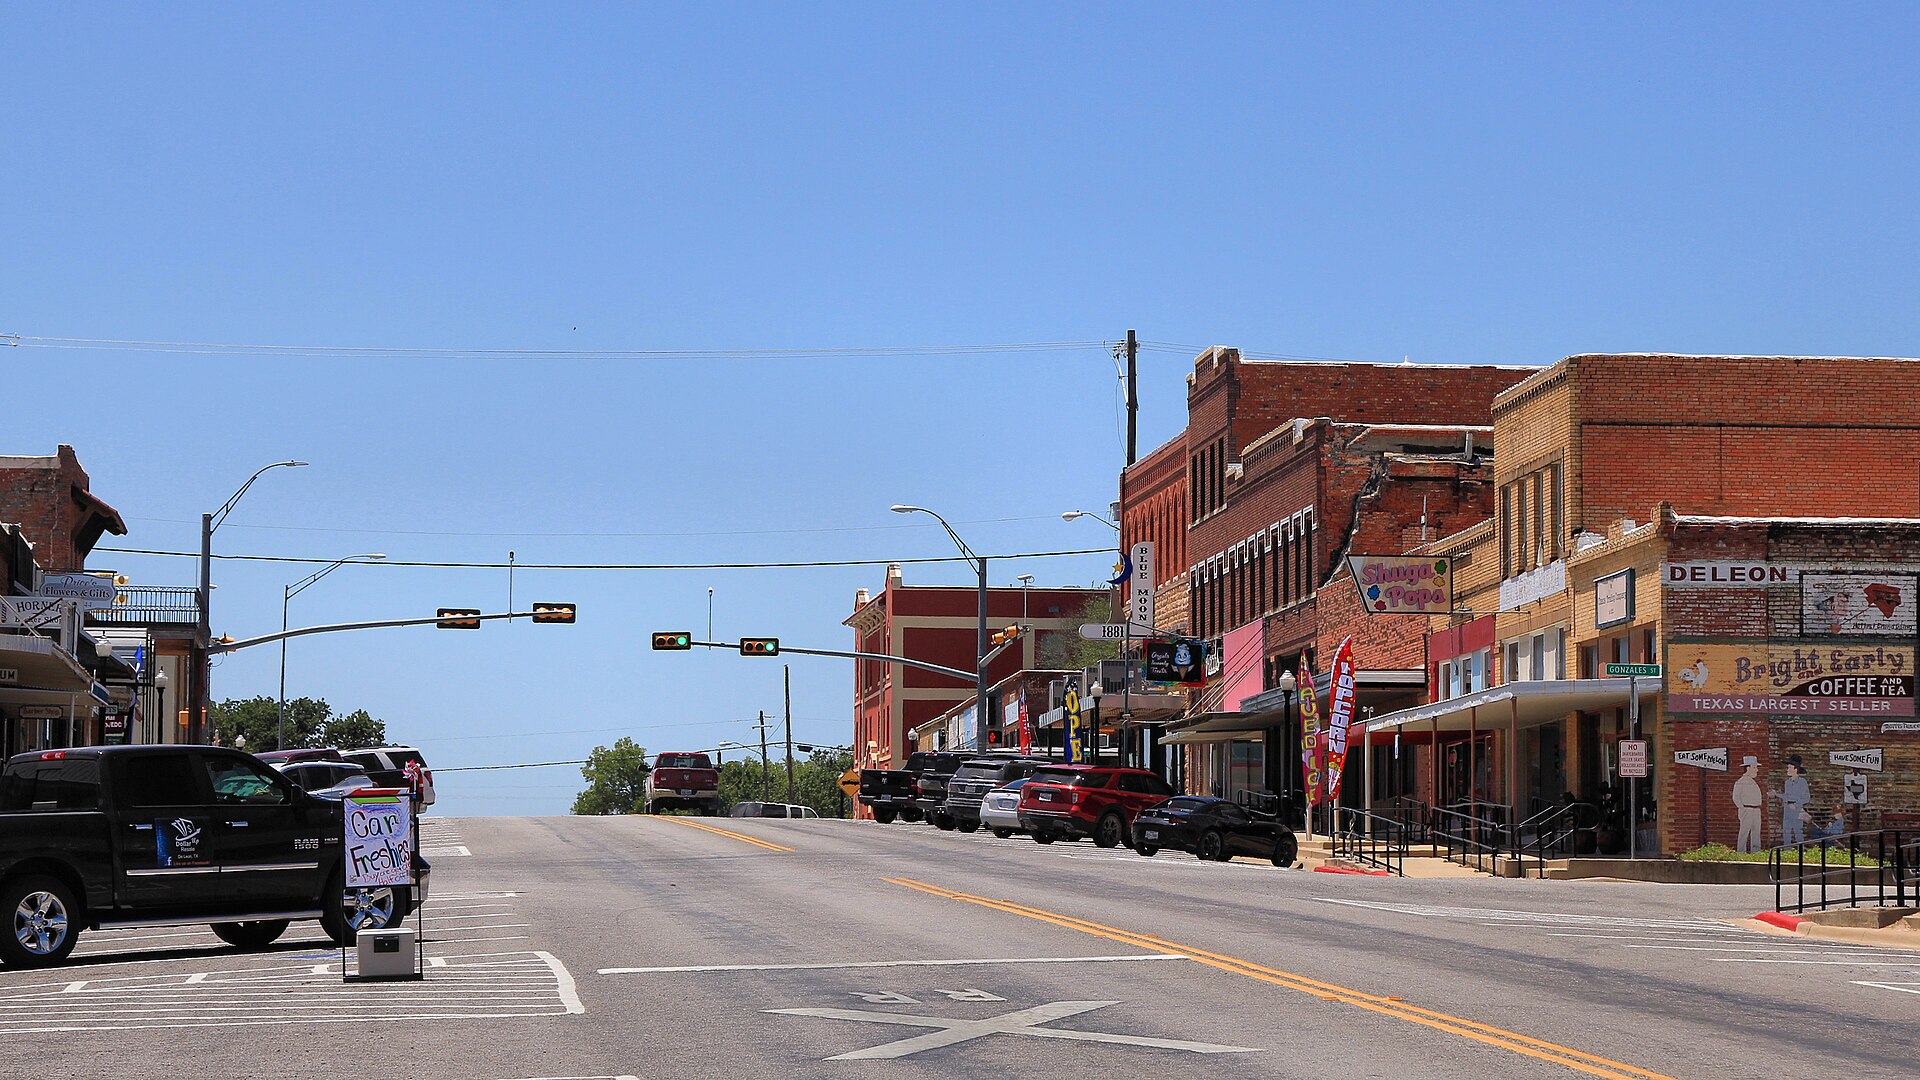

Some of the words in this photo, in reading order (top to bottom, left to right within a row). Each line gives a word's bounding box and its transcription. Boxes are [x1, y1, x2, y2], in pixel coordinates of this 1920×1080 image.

[1139, 547, 1148, 580] BLUE
[61, 576, 97, 588] Price's
[1361, 562, 1436, 586] Shuga
[1669, 566, 1787, 582] DELEON
[45, 586, 79, 597] Flowers
[89, 589, 110, 598] Gifts
[1384, 586, 1446, 610] Pops
[16, 601, 62, 614] HORNER
[1137, 589, 1149, 621] MOON
[1102, 626, 1124, 638] 1881
[1609, 666, 1647, 674] GONZALES
[1735, 648, 1820, 687] Bright
[1830, 647, 1904, 675] Early
[1798, 663, 1823, 680] and
[1808, 677, 1877, 696] COFFEE
[1880, 685, 1906, 696] TEA
[1329, 662, 1354, 754] POPCORN
[1693, 698, 1745, 710] TEXAS
[1749, 698, 1820, 711] LARGEST
[1829, 700, 1891, 712] SELLER
[1066, 690, 1082, 762] OPE
[1678, 752, 1690, 760] EAT
[1691, 752, 1707, 761] SOME
[1849, 753, 1865, 763] SOME
[1866, 753, 1880, 765] FUN
[351, 811, 400, 838] Car
[349, 839, 410, 877] Freshies
